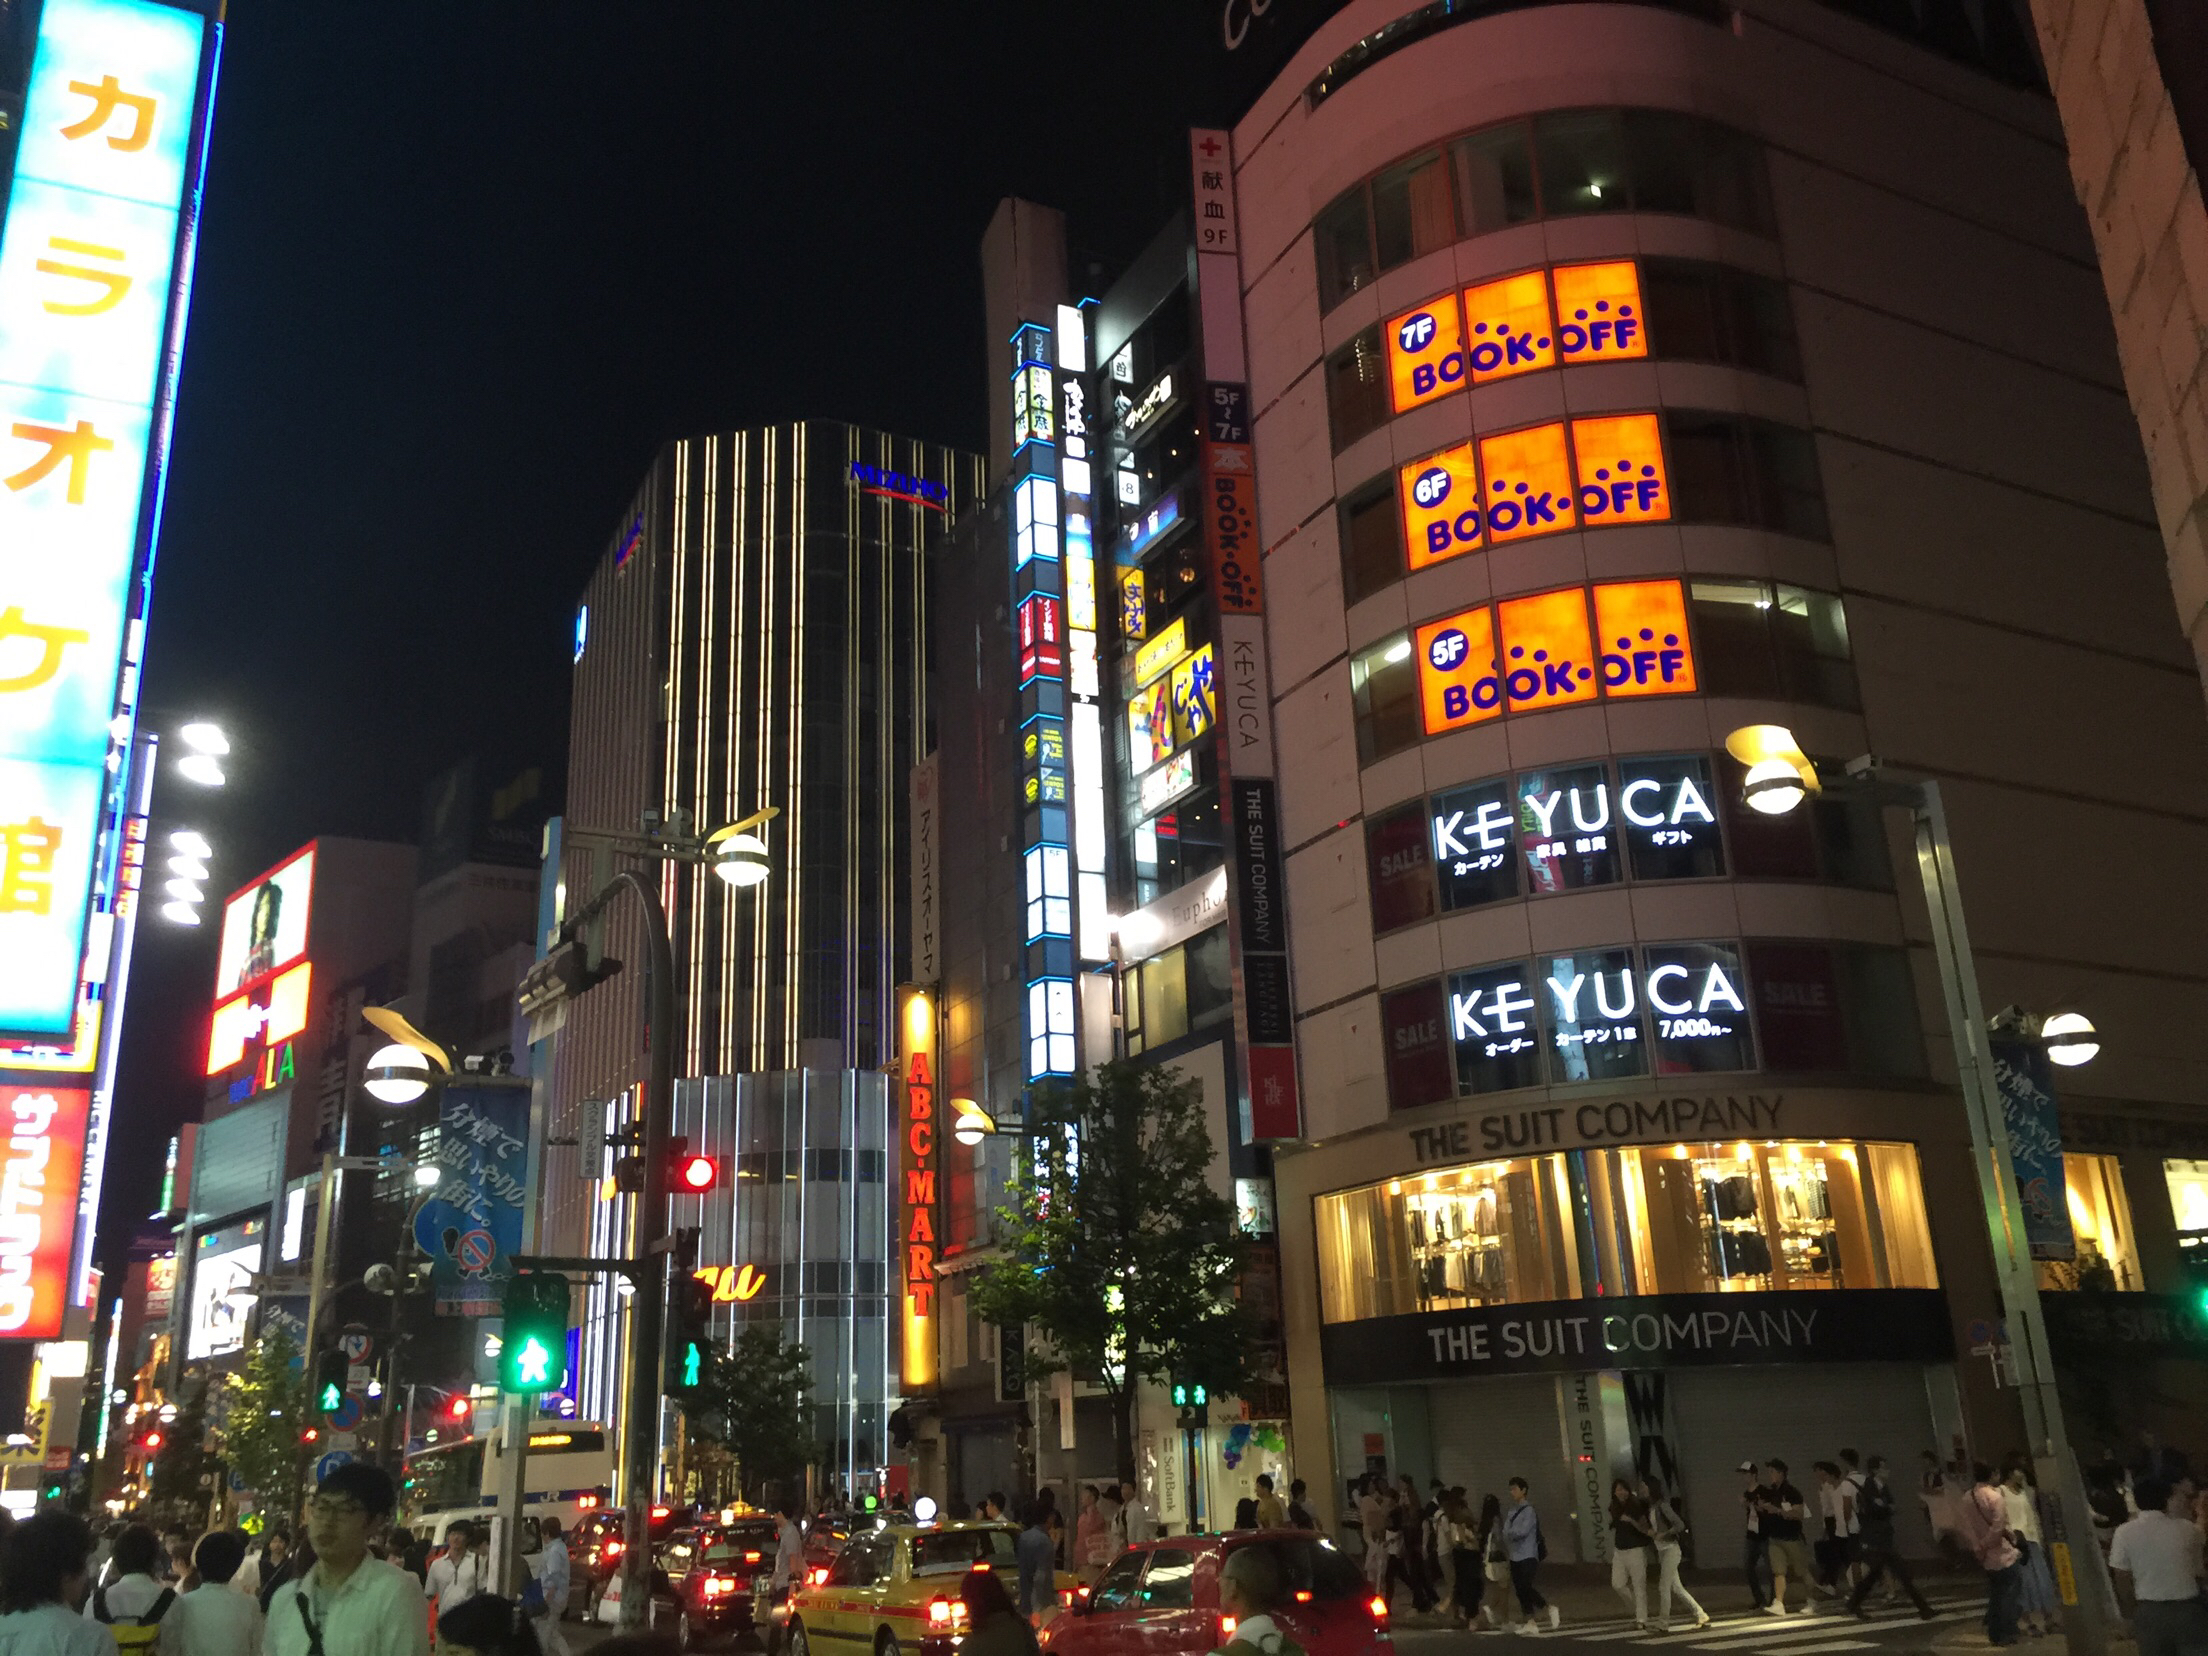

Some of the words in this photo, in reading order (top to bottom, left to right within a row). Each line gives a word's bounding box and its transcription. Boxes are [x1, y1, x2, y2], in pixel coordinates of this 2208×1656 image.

[1202, 171, 1225, 219] 献血
[1204, 229, 1227, 244] 9F
[1401, 317, 1433, 349] 7F
[1415, 471, 1448, 503] 6F
[1431, 633, 1464, 666] 5F
[1233, 640, 1259, 749] KEYUCA
[1247, 788, 1262, 819] THE
[1434, 776, 1715, 860] KEYUCA
[1249, 823, 1266, 864] SUIT
[1380, 844, 1423, 878] SALE
[1453, 853, 1505, 876] カーテン
[1651, 830, 1693, 846] ギフト
[920, 808, 934, 975] アイリスオーヤマ
[1251, 866, 1271, 944] COMPANY
[1453, 961, 1745, 1041] KEYUCA
[1394, 1018, 1439, 1050] SALE
[1485, 1037, 1535, 1058] オーダー
[1555, 1026, 1612, 1047] カーテン
[442, 1102, 523, 1160] 分煙で
[1409, 1120, 1471, 1163] THE
[1480, 1108, 1565, 1152] SUIT
[1576, 1095, 1784, 1140] COMPANY
[438, 1137, 528, 1208] 思いやりの
[907, 1052, 936, 1318] ABC-MART
[1428, 1324, 1491, 1363] THE
[1502, 1318, 1589, 1359] SUIT
[1602, 1308, 1819, 1353] COMPANY
[1575, 1373, 1590, 1414] THE
[1579, 1420, 1596, 1463] SUIT
[1163, 1455, 1176, 1514] SoftBank
